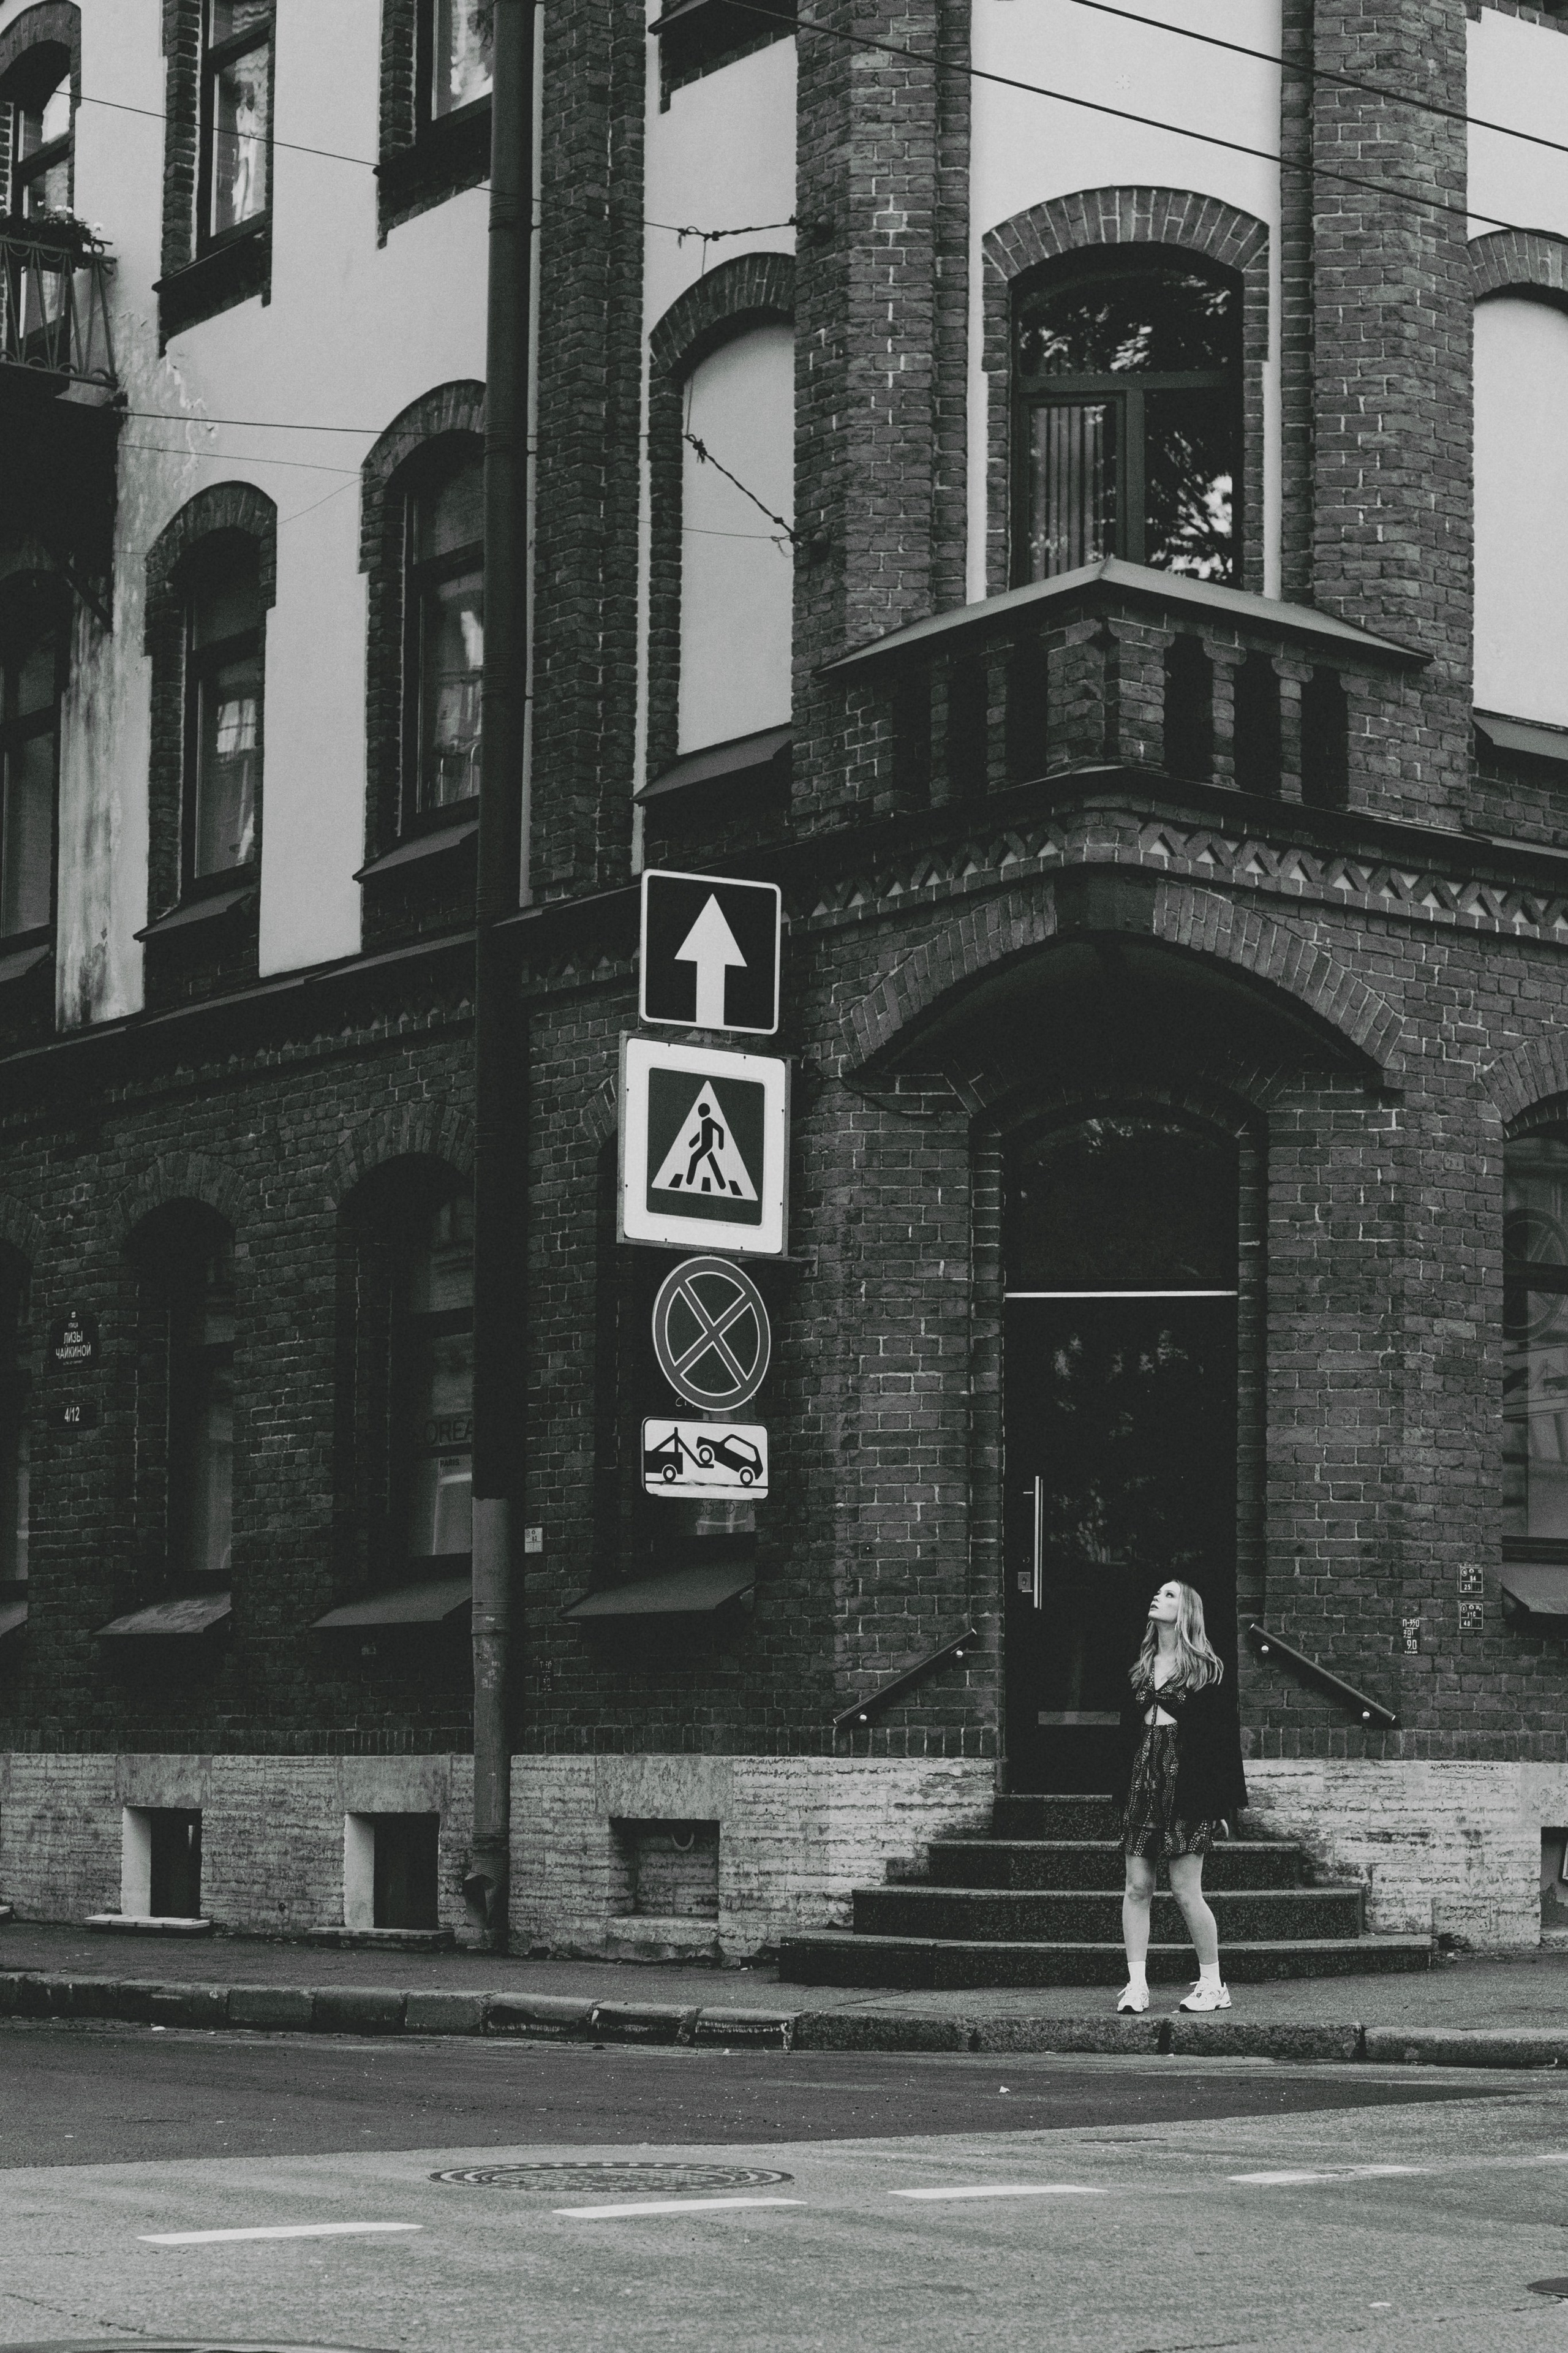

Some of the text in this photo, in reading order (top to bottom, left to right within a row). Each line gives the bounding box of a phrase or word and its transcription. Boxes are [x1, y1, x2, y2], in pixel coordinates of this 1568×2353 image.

[63, 1330, 83, 1345] ЛИЗЫ
[56, 1342, 91, 1359] ЧАЙКИНОЙ
[64, 1406, 80, 1422] 4/12
[440, 1458, 460, 1468] PARIS
